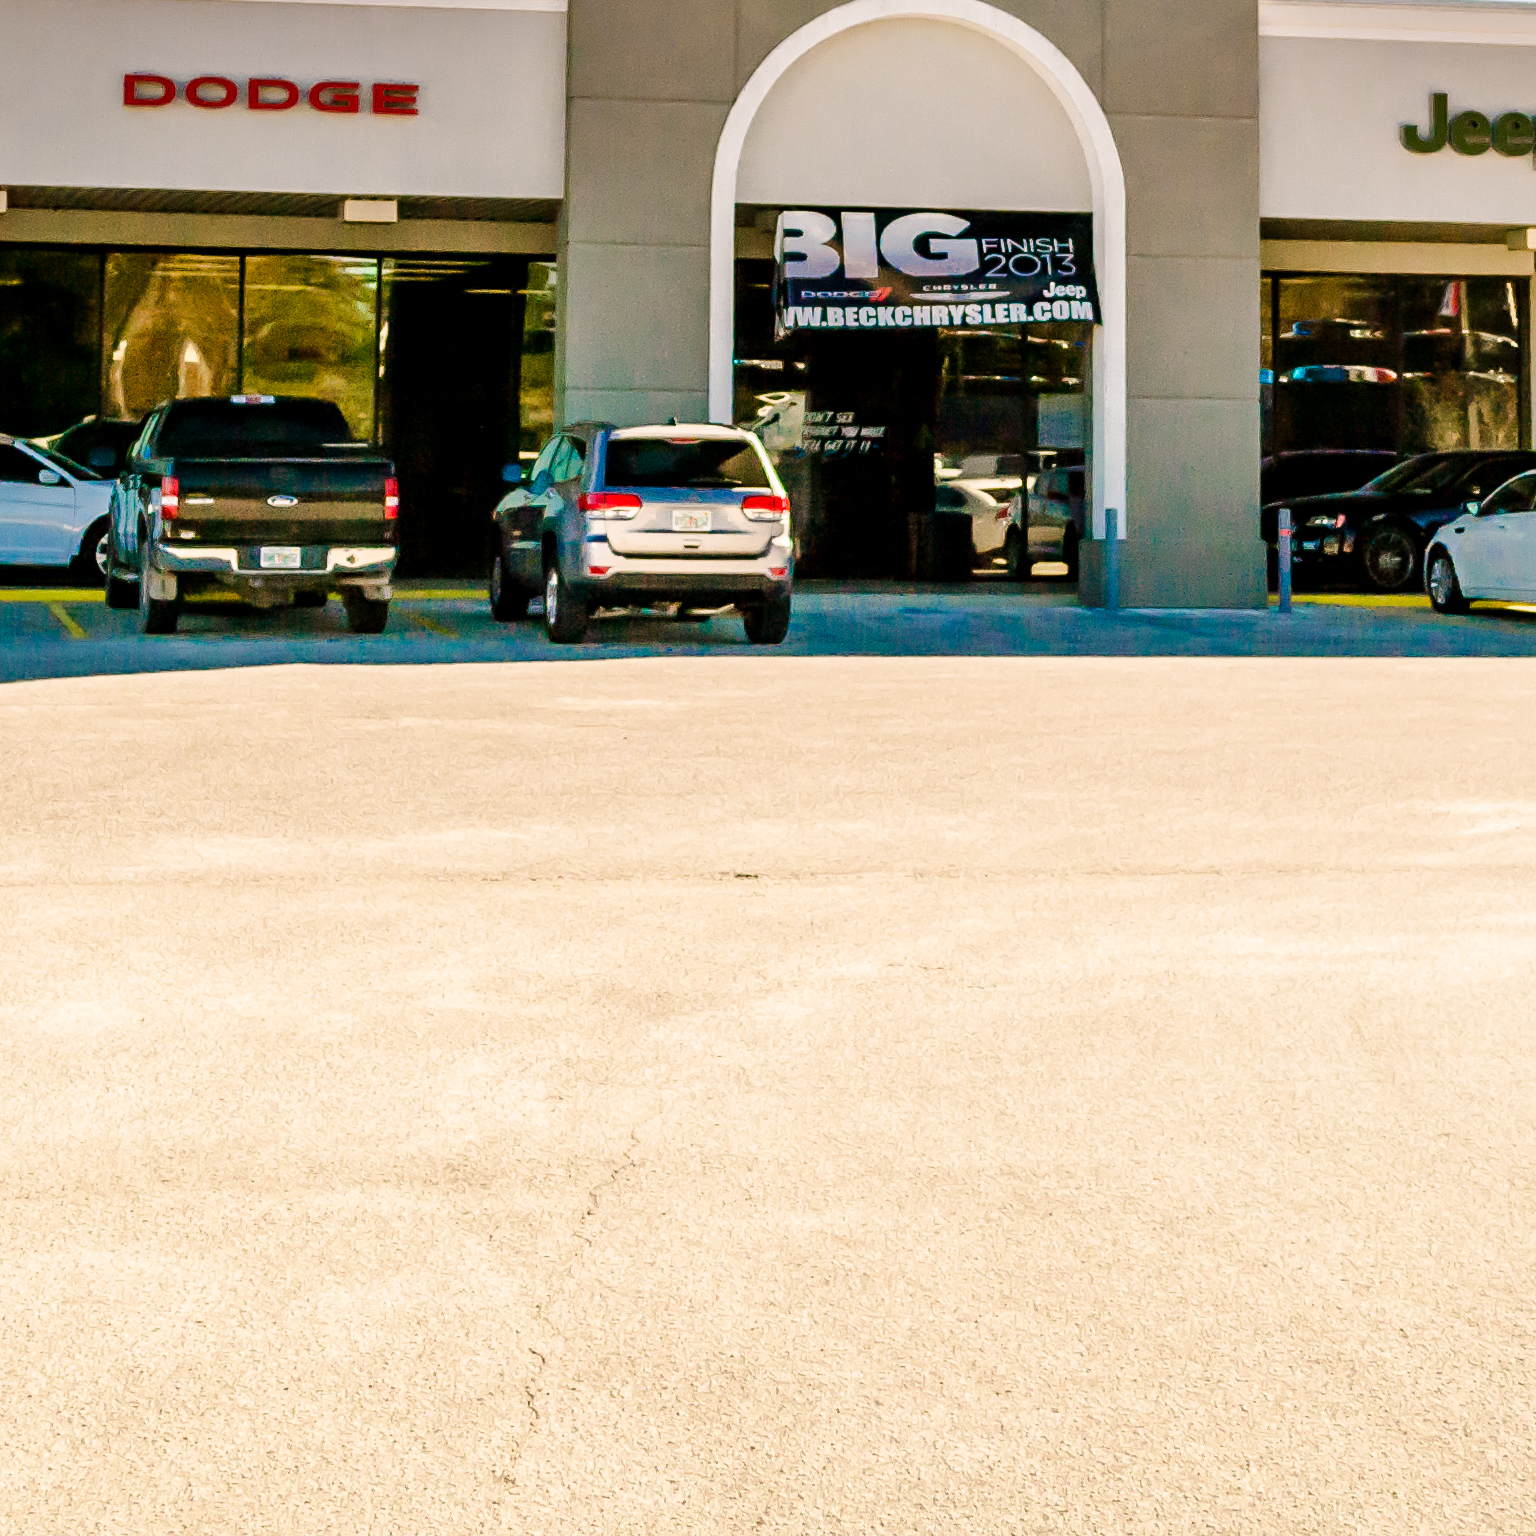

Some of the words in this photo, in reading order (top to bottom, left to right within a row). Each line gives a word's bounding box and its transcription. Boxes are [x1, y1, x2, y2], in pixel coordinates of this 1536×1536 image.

[123, 74, 419, 115] DODGE
[774, 211, 980, 278] BIG
[981, 237, 1074, 254] FINISH
[984, 253, 1076, 277] 2013
[1042, 281, 1087, 299] Jeep
